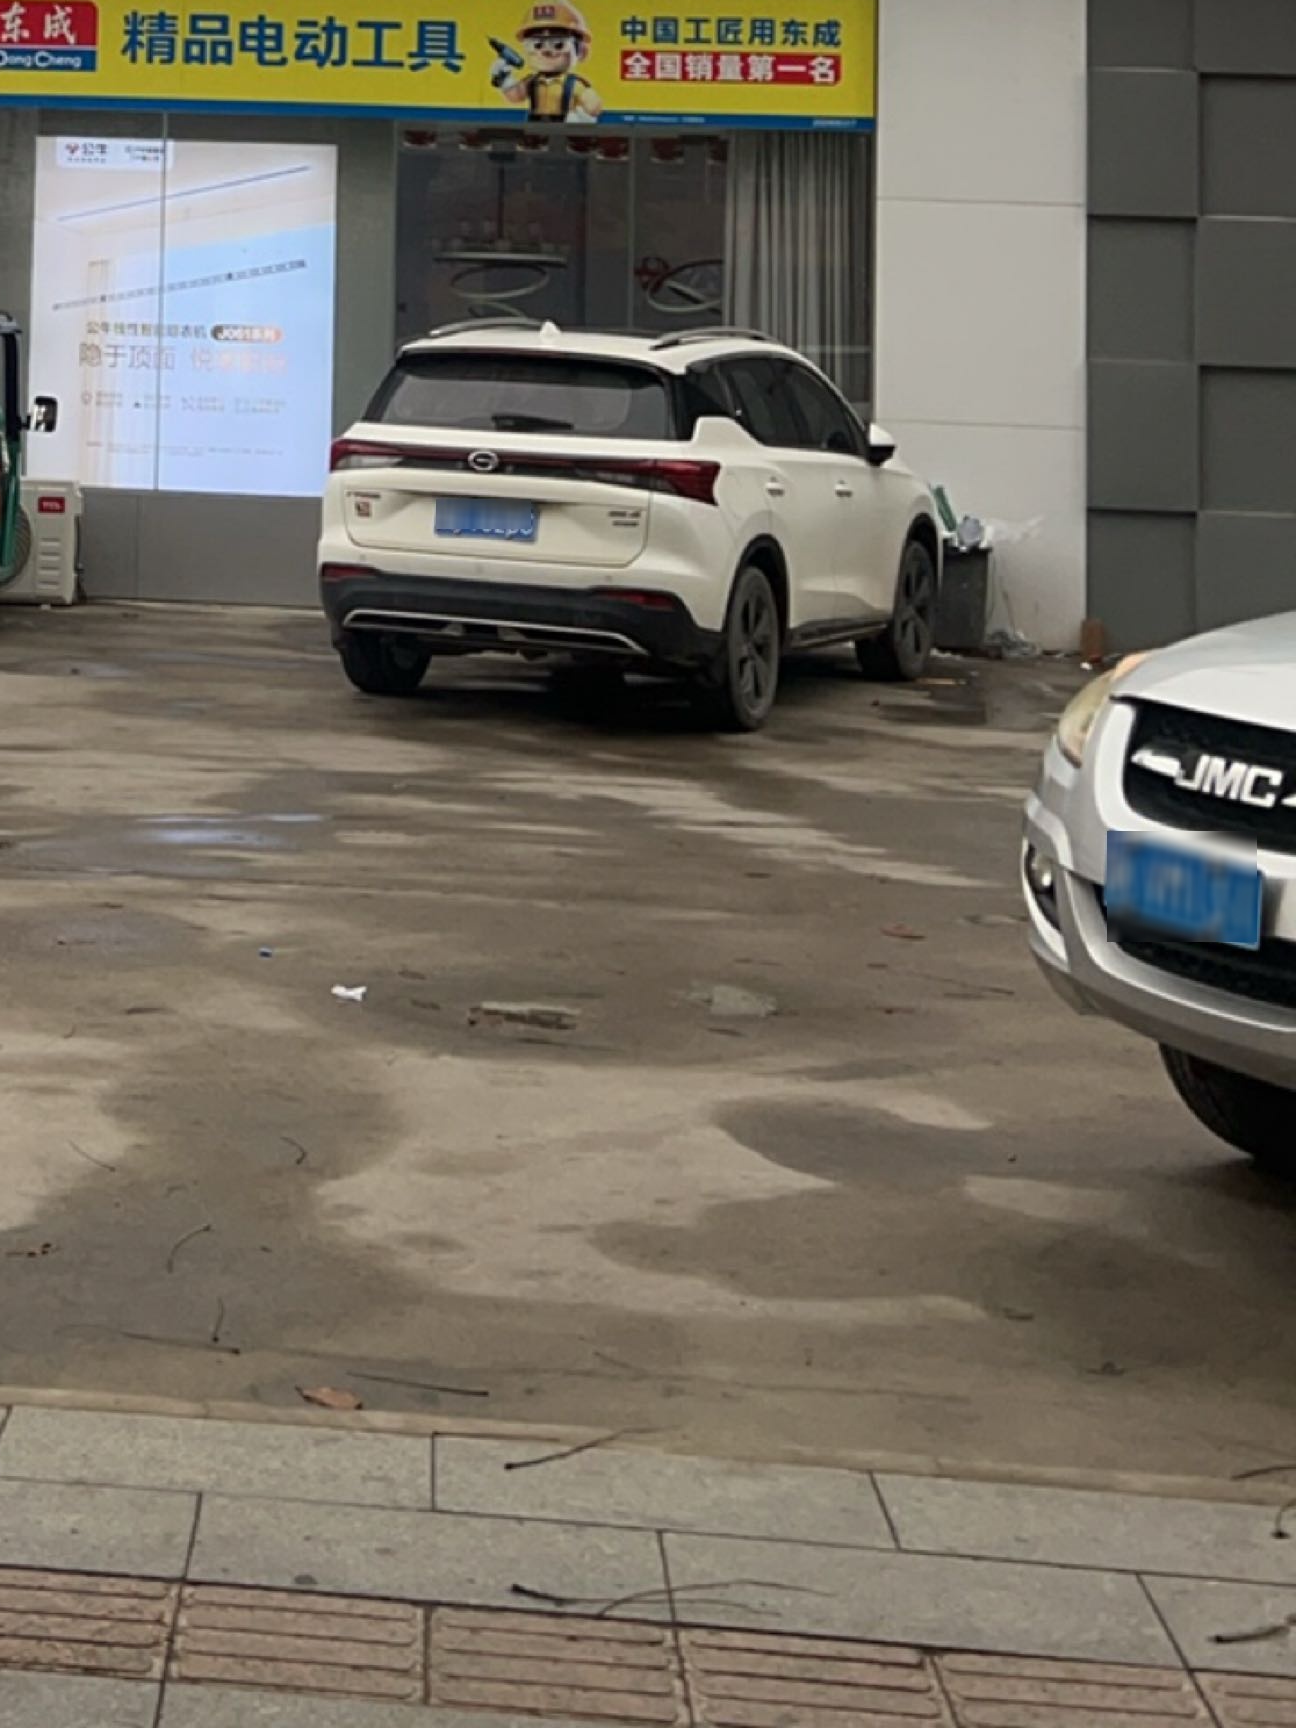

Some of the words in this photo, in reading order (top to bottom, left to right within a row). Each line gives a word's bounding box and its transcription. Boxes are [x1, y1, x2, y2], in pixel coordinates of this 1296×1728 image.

[0, 1, 76, 44] 东成
[121, 10, 466, 72] 精品电动工具
[620, 15, 843, 49] 中国工匠用东成
[624, 51, 836, 84] 全国销量第一名
[1175, 755, 1283, 808] JMC
